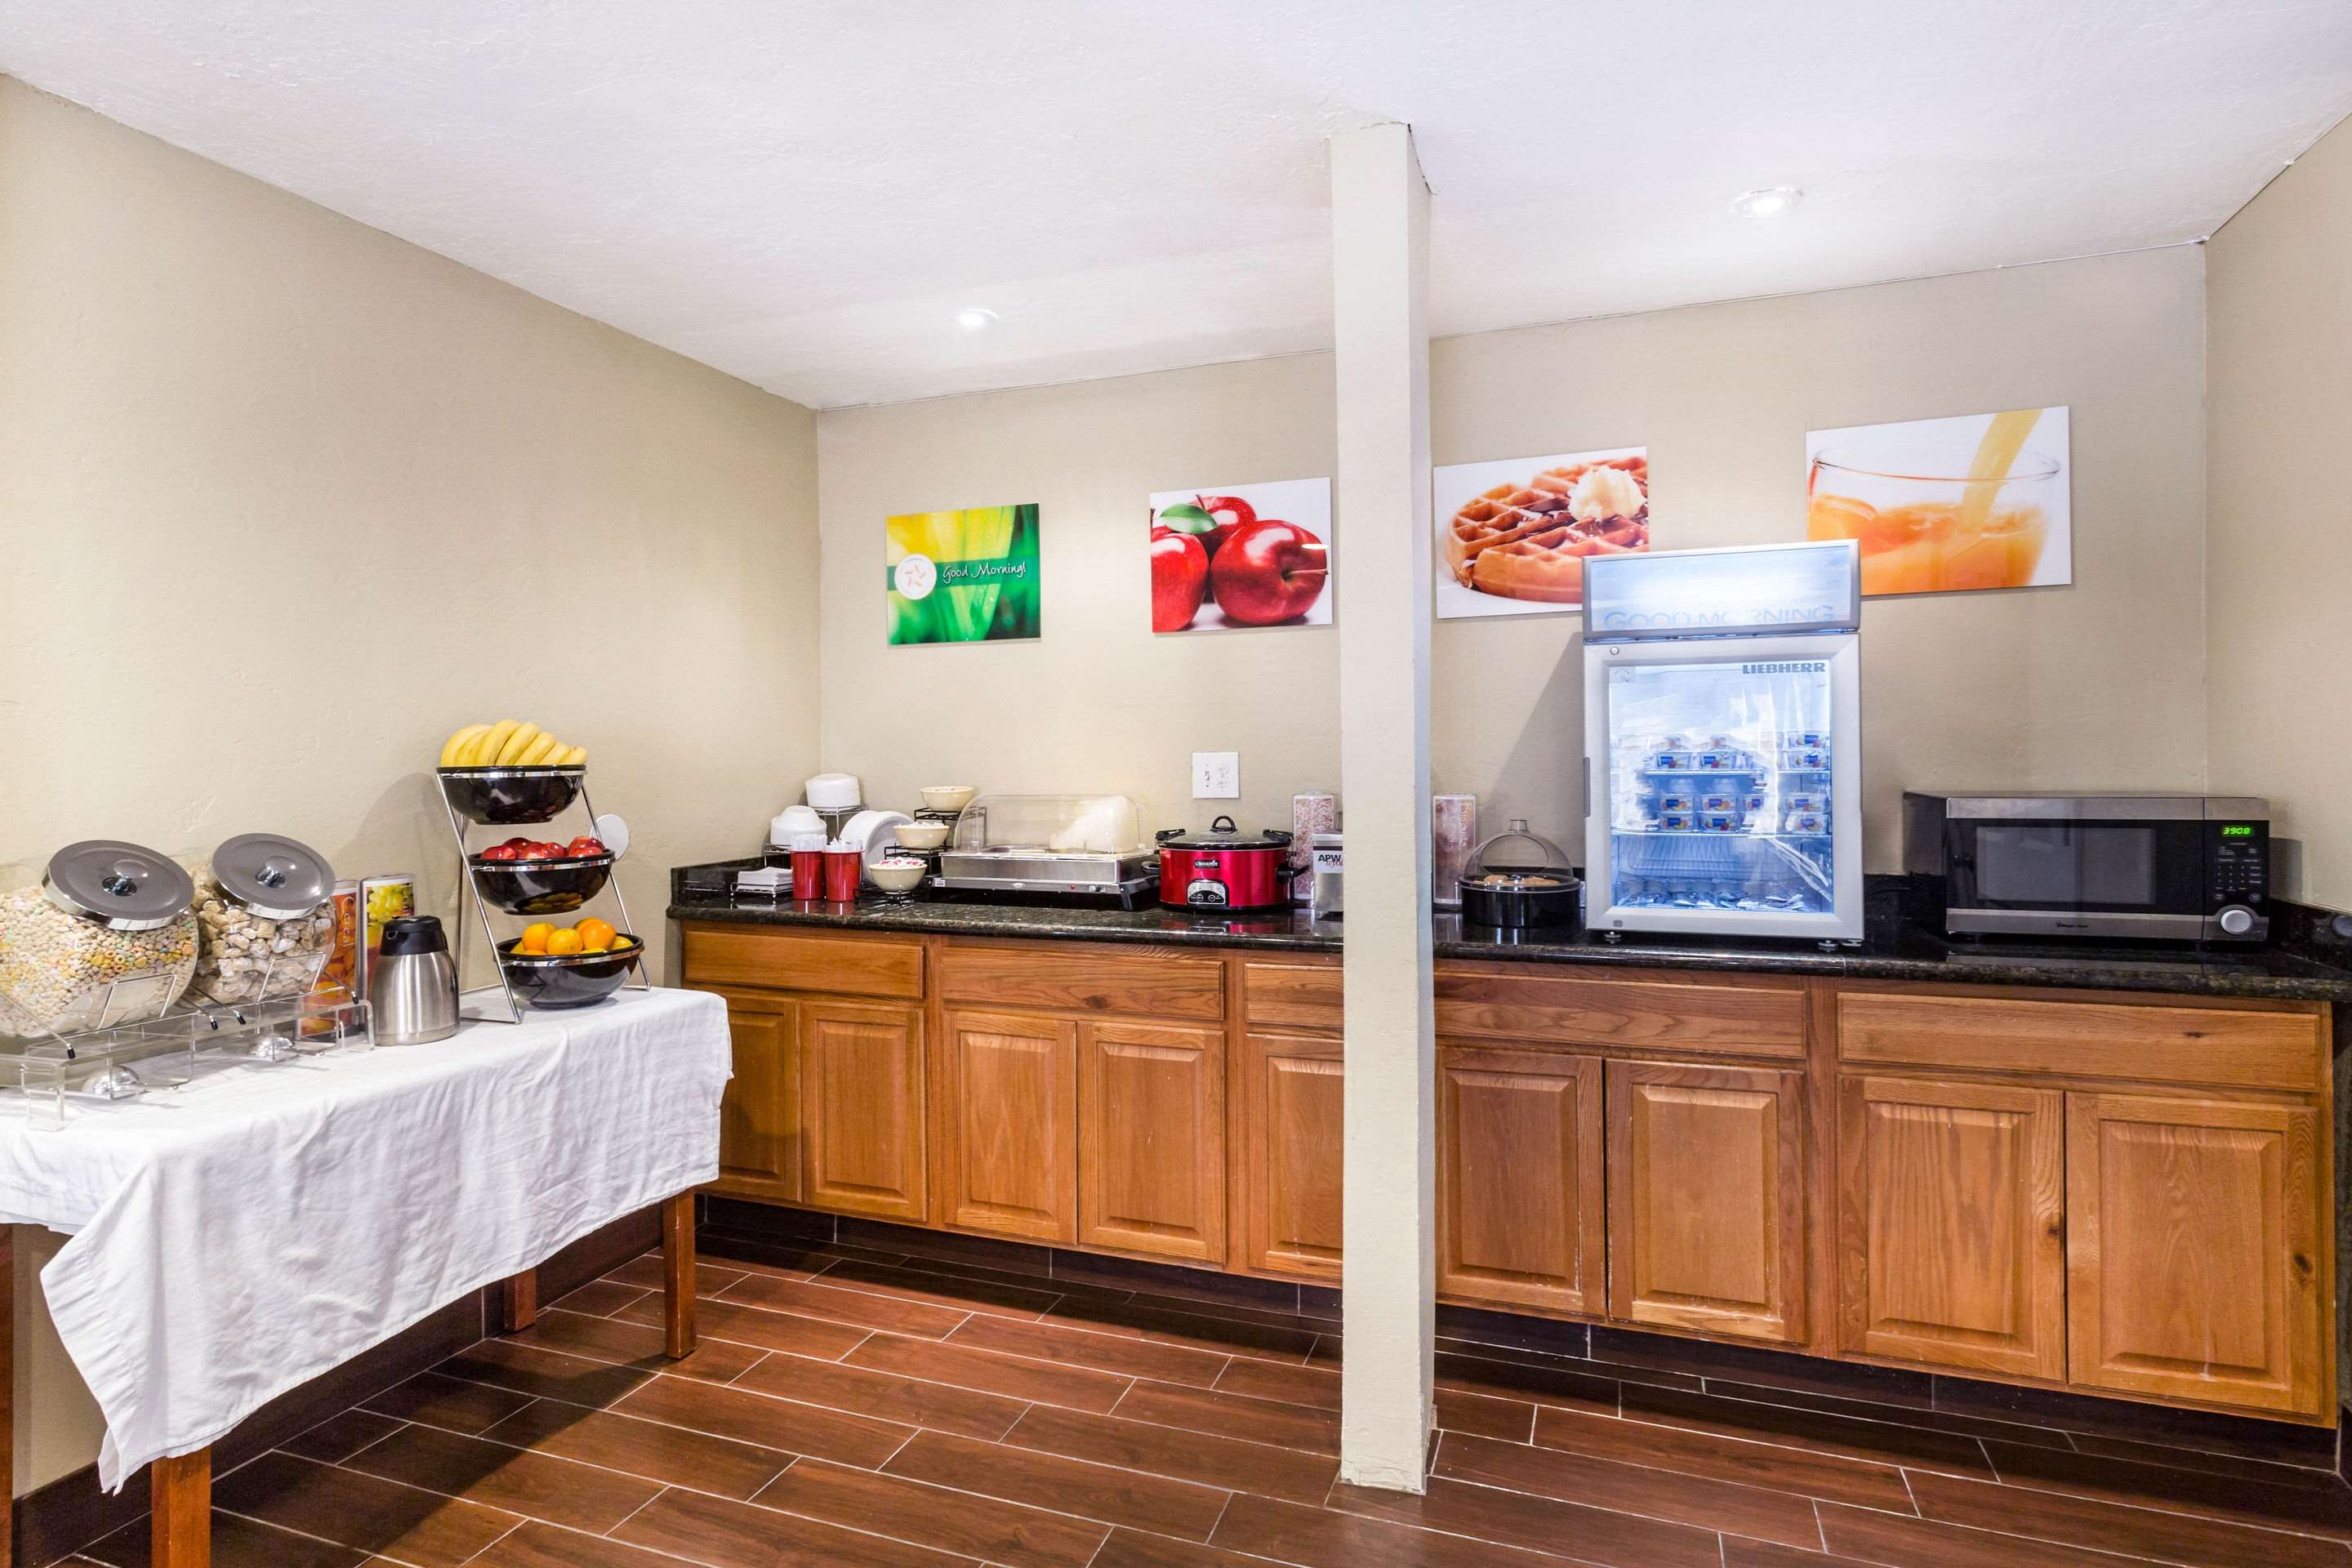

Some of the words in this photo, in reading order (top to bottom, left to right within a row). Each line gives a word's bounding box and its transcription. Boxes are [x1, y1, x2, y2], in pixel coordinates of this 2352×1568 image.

[942, 564, 968, 584] Good
[971, 561, 1027, 578] Morning!
[1603, 610, 1692, 630] GOOD
[1742, 662, 1825, 674] LIEBHERR
